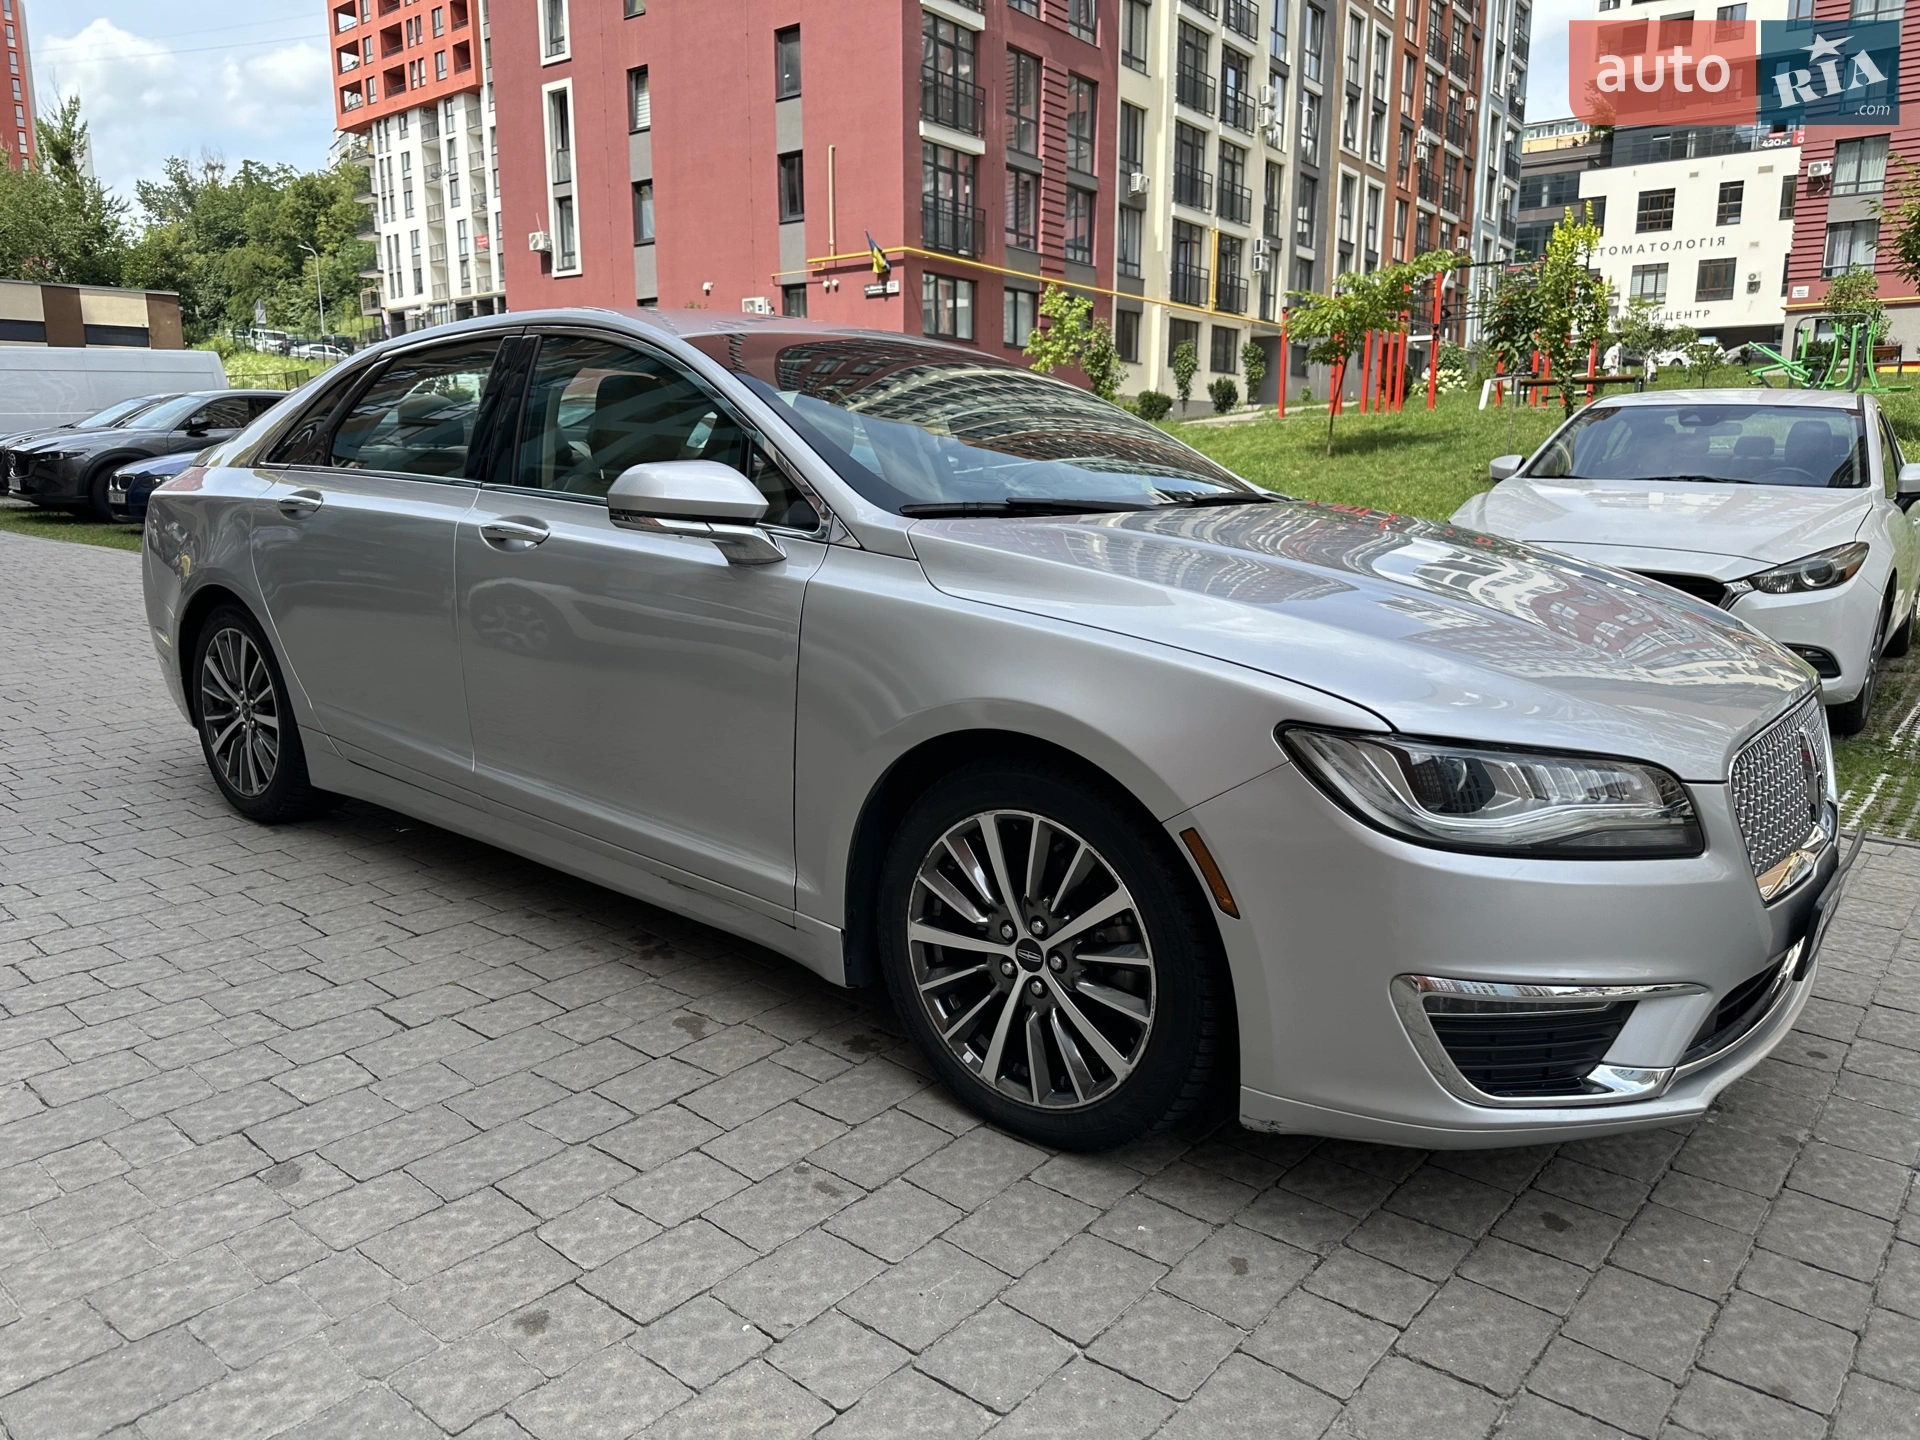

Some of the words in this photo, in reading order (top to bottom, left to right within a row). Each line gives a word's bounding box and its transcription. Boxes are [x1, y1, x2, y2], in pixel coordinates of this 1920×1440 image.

[1761, 138, 1781, 147] 420
[1598, 236, 1726, 257] ТОМАТОЛОГІЯ
[1665, 309, 1711, 321] ЦЕНТР
